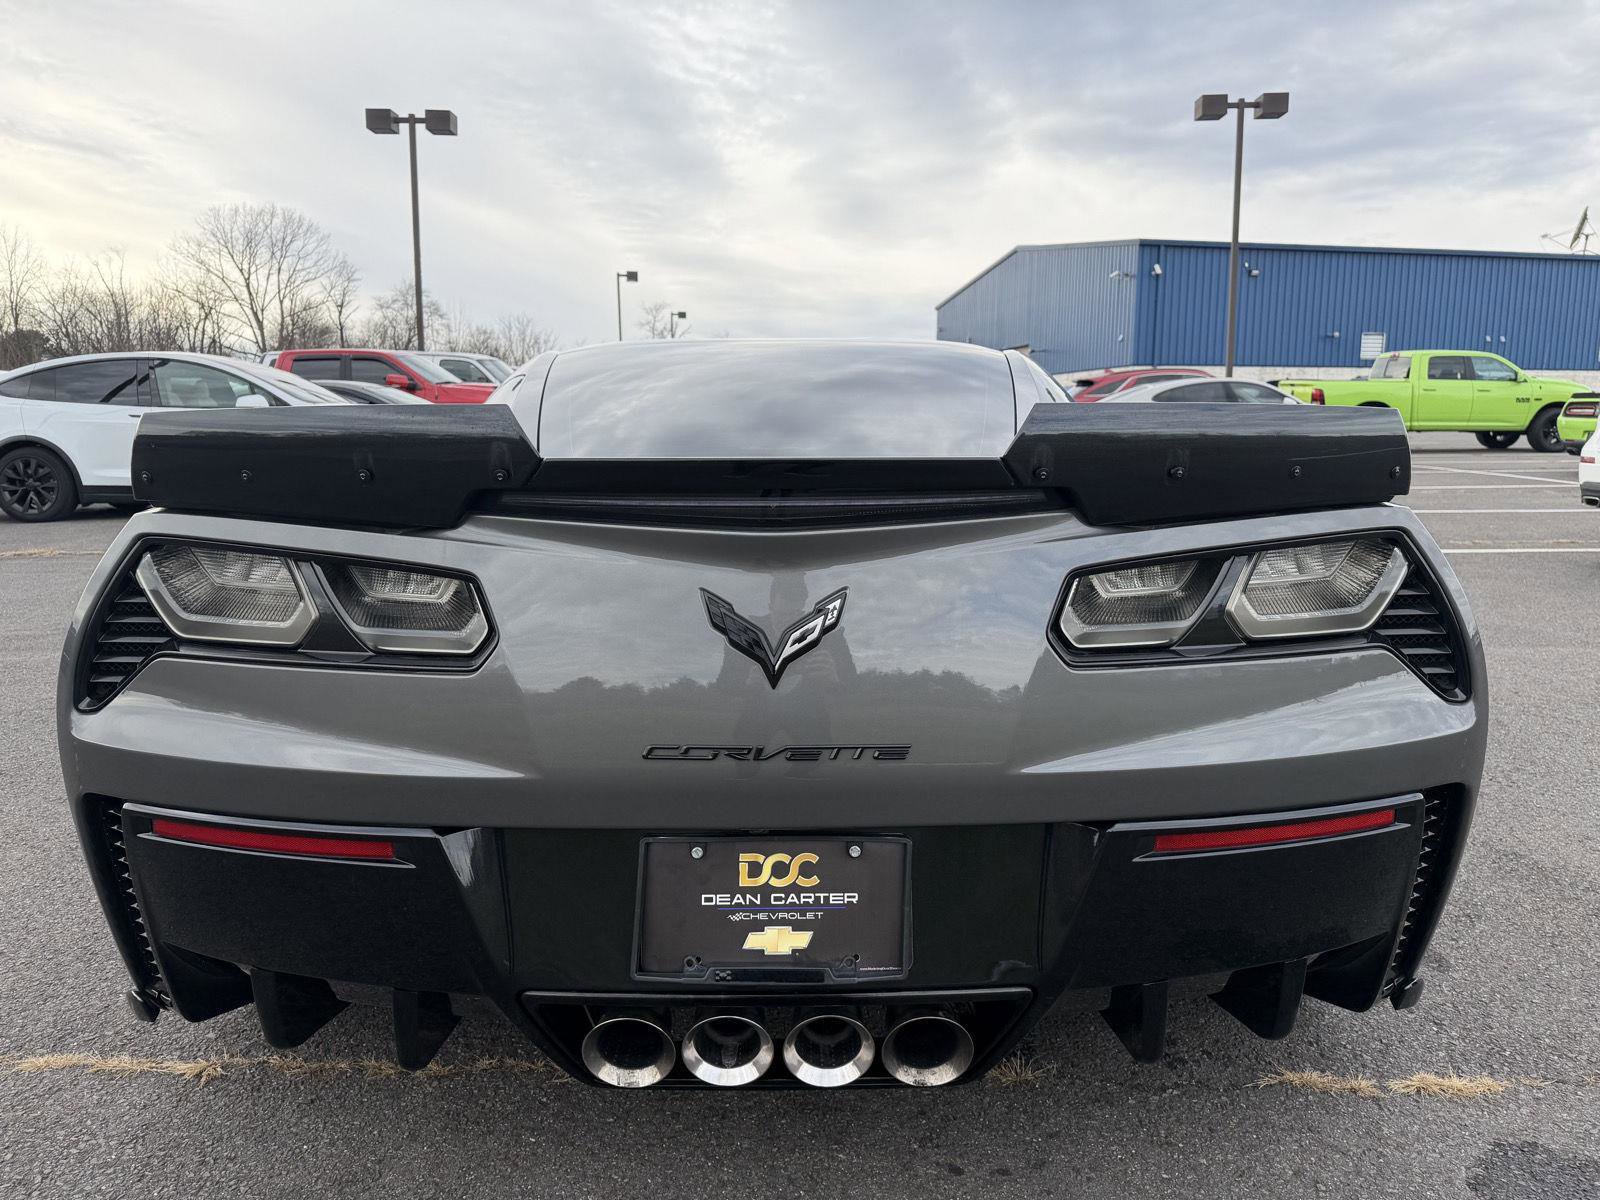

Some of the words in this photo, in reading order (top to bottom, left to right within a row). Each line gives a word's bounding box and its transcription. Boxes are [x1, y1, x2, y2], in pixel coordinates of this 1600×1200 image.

[641, 744, 912, 761] CORVETTE
[701, 893, 761, 906] DEAN
[770, 892, 859, 905] CARTER
[740, 912, 824, 920] CHEVROLET
